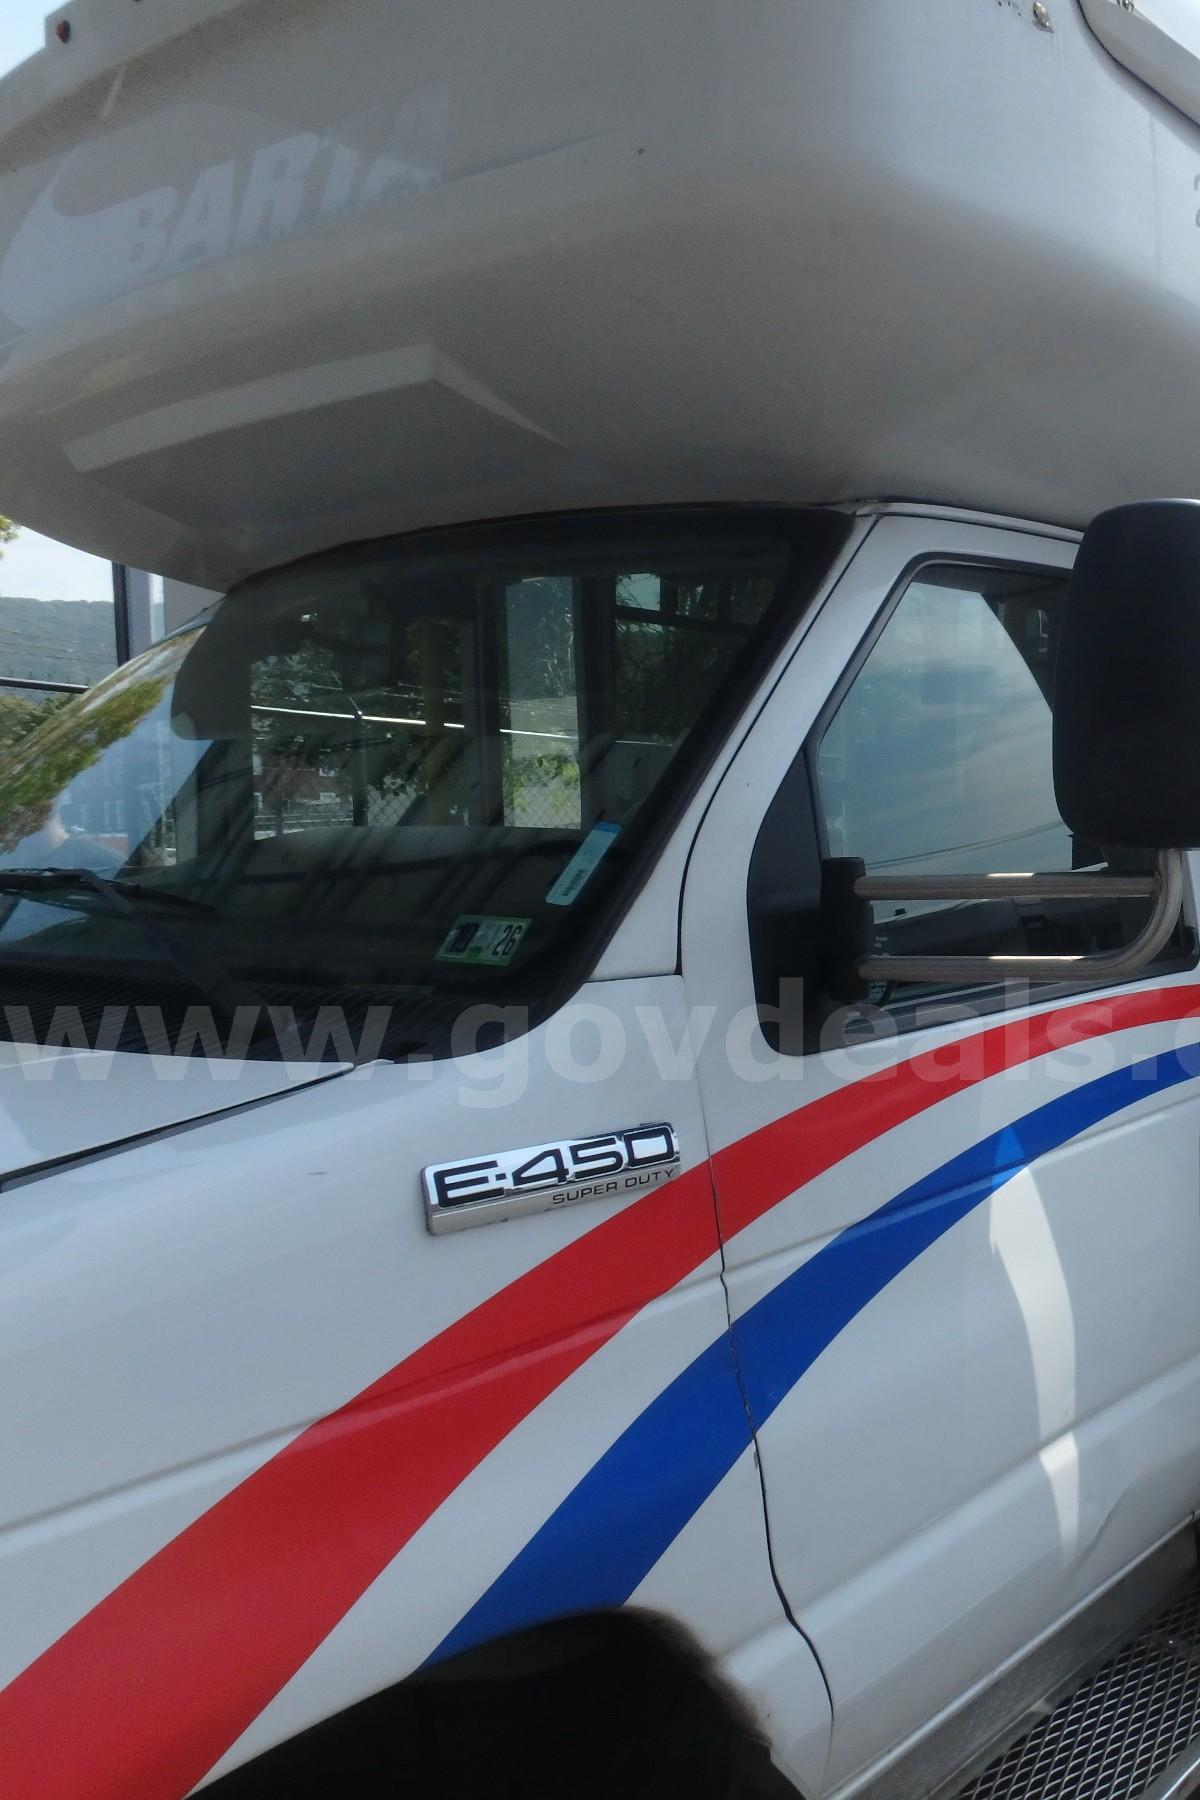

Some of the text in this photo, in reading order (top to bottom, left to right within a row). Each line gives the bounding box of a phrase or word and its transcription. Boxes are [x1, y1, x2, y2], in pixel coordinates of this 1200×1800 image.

[492, 924, 524, 957] 26
[433, 1126, 676, 1208] E-450
[552, 1167, 675, 1205] SUPER DUTY
